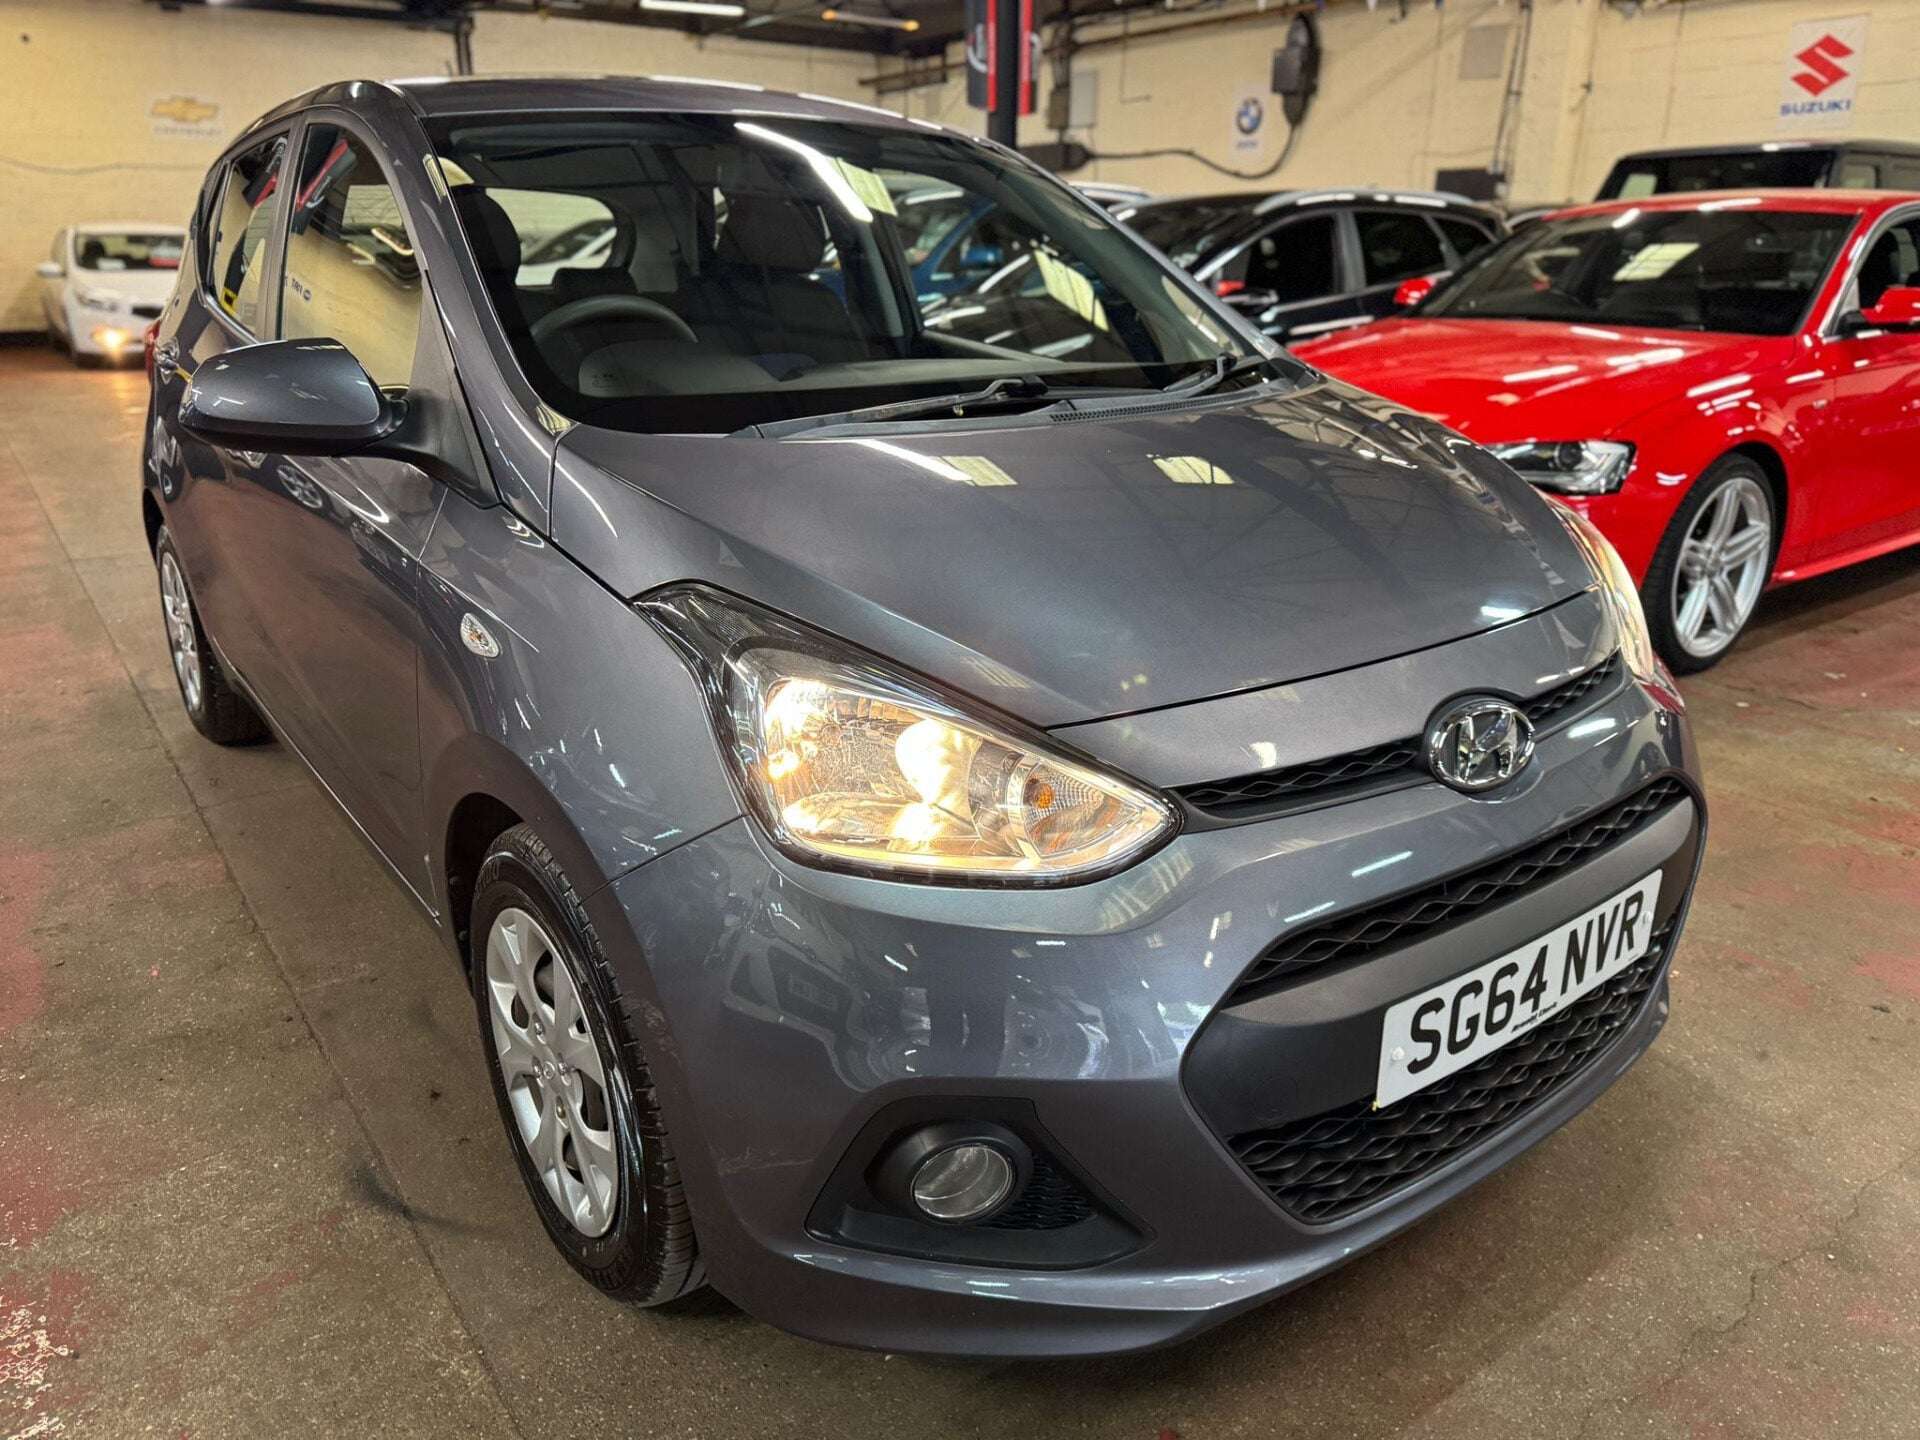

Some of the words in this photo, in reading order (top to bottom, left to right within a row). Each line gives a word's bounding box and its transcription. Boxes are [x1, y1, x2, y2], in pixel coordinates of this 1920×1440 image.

[1780, 99, 1851, 116] SUZUKI
[1407, 943, 1549, 1075] SG64
[1560, 890, 1644, 996] NVR
